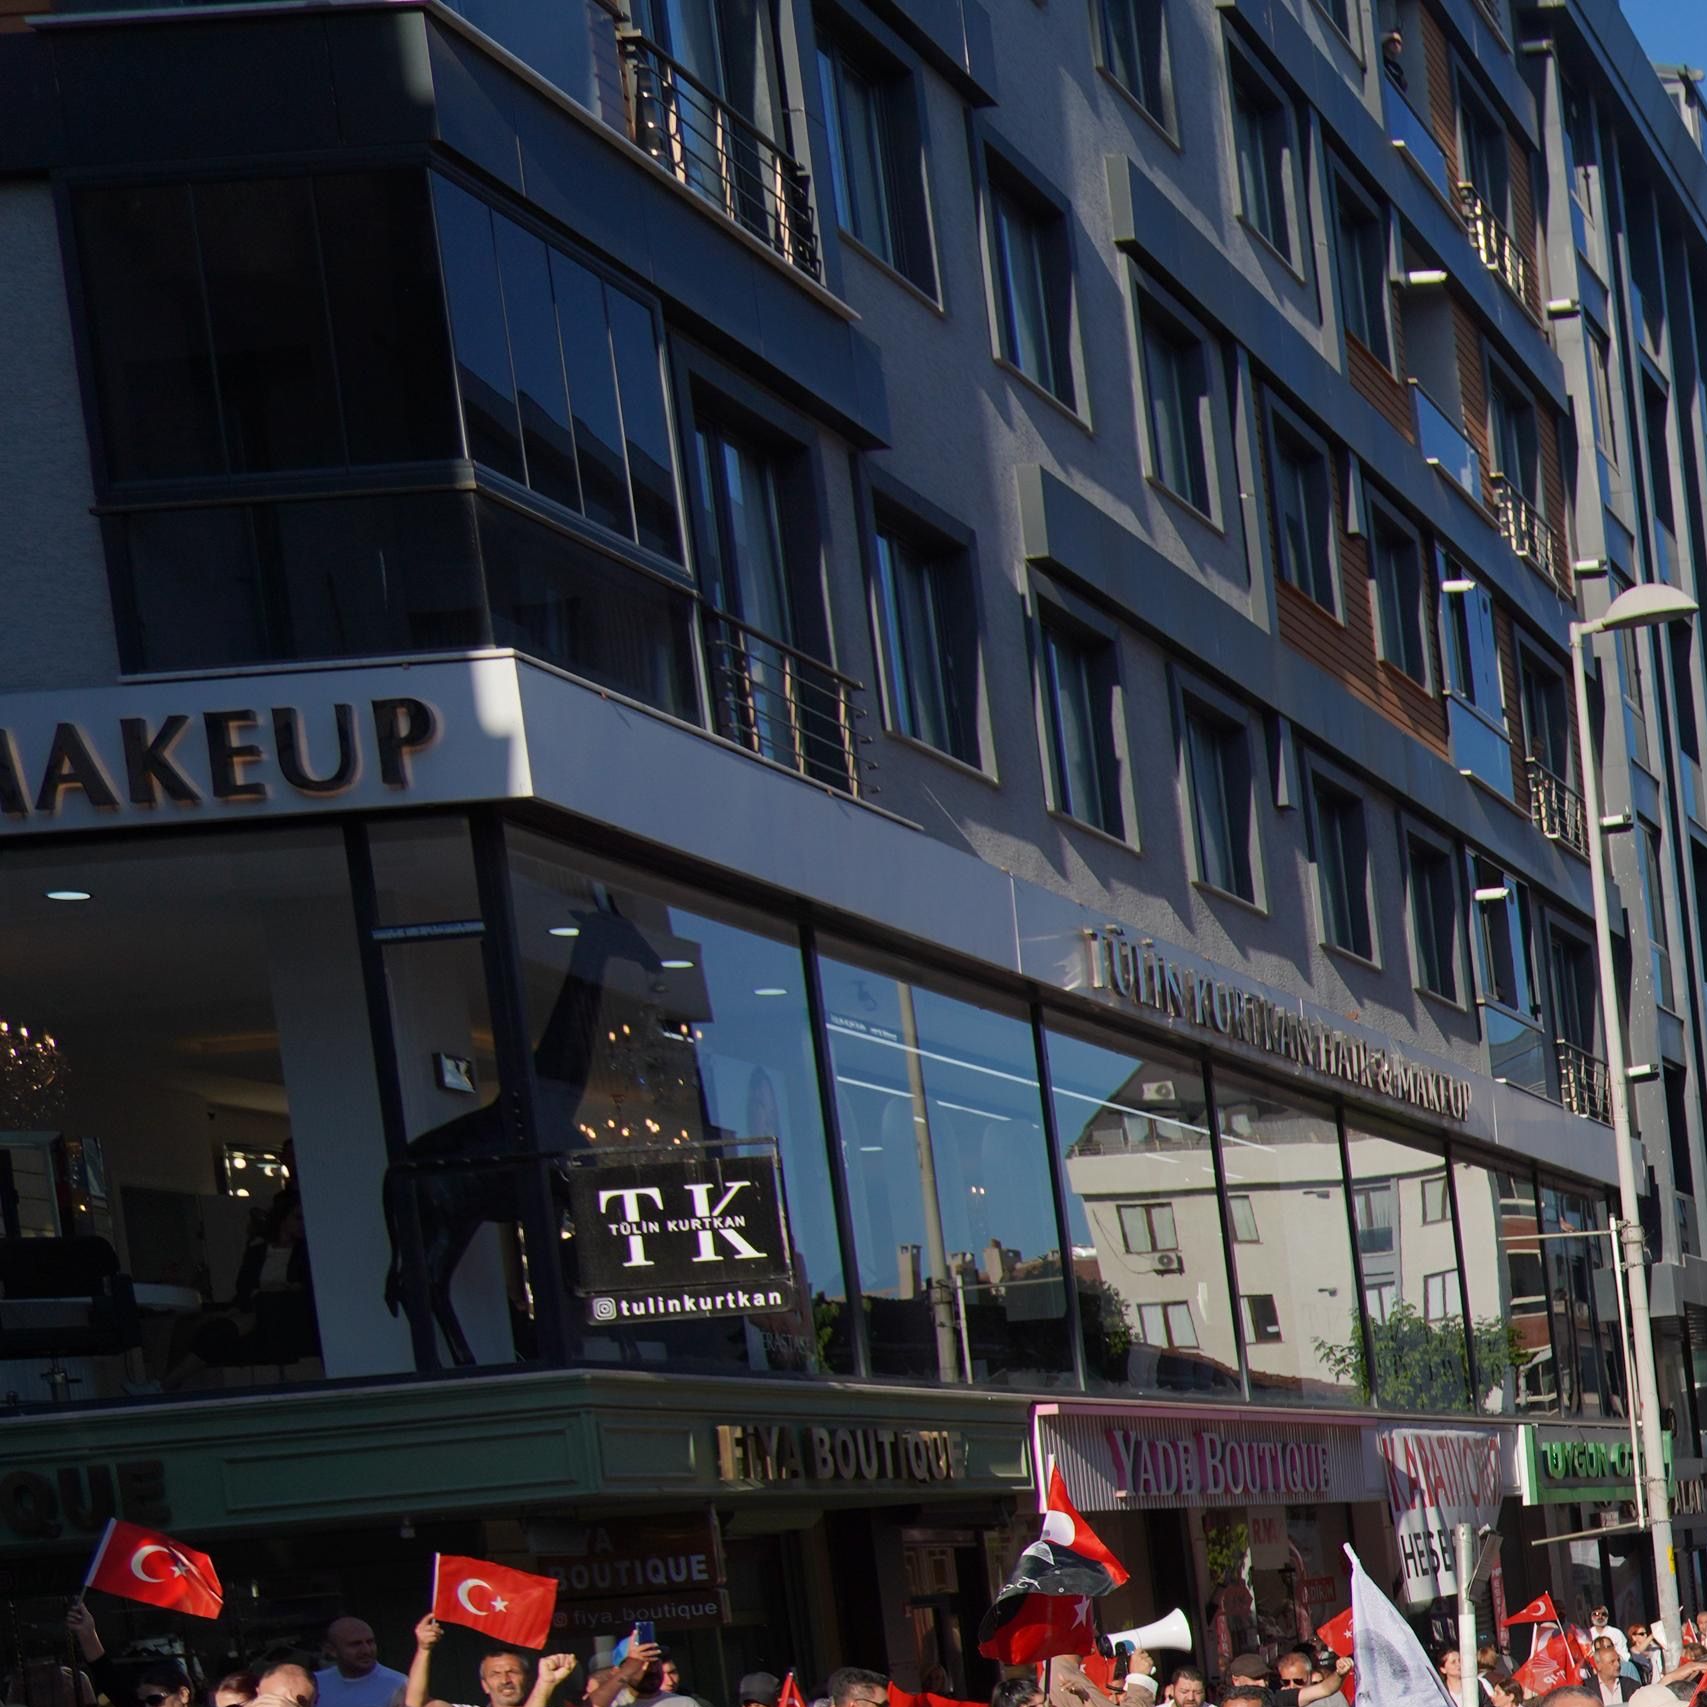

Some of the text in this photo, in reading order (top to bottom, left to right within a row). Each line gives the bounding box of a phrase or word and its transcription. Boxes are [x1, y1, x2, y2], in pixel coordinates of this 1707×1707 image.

[1083, 925, 1185, 1018] TÜLİN
[609, 1215, 747, 1236] TÜLİN KURTKAN
[620, 1290, 782, 1317] tulinkurtkan
[1110, 1429, 1330, 1497] YADE BOUTIQUE
[1543, 1442, 1608, 1480] UYGUN
[550, 1553, 710, 1592] BOUTIQUE
[574, 1602, 719, 1628] fiya_boutique
